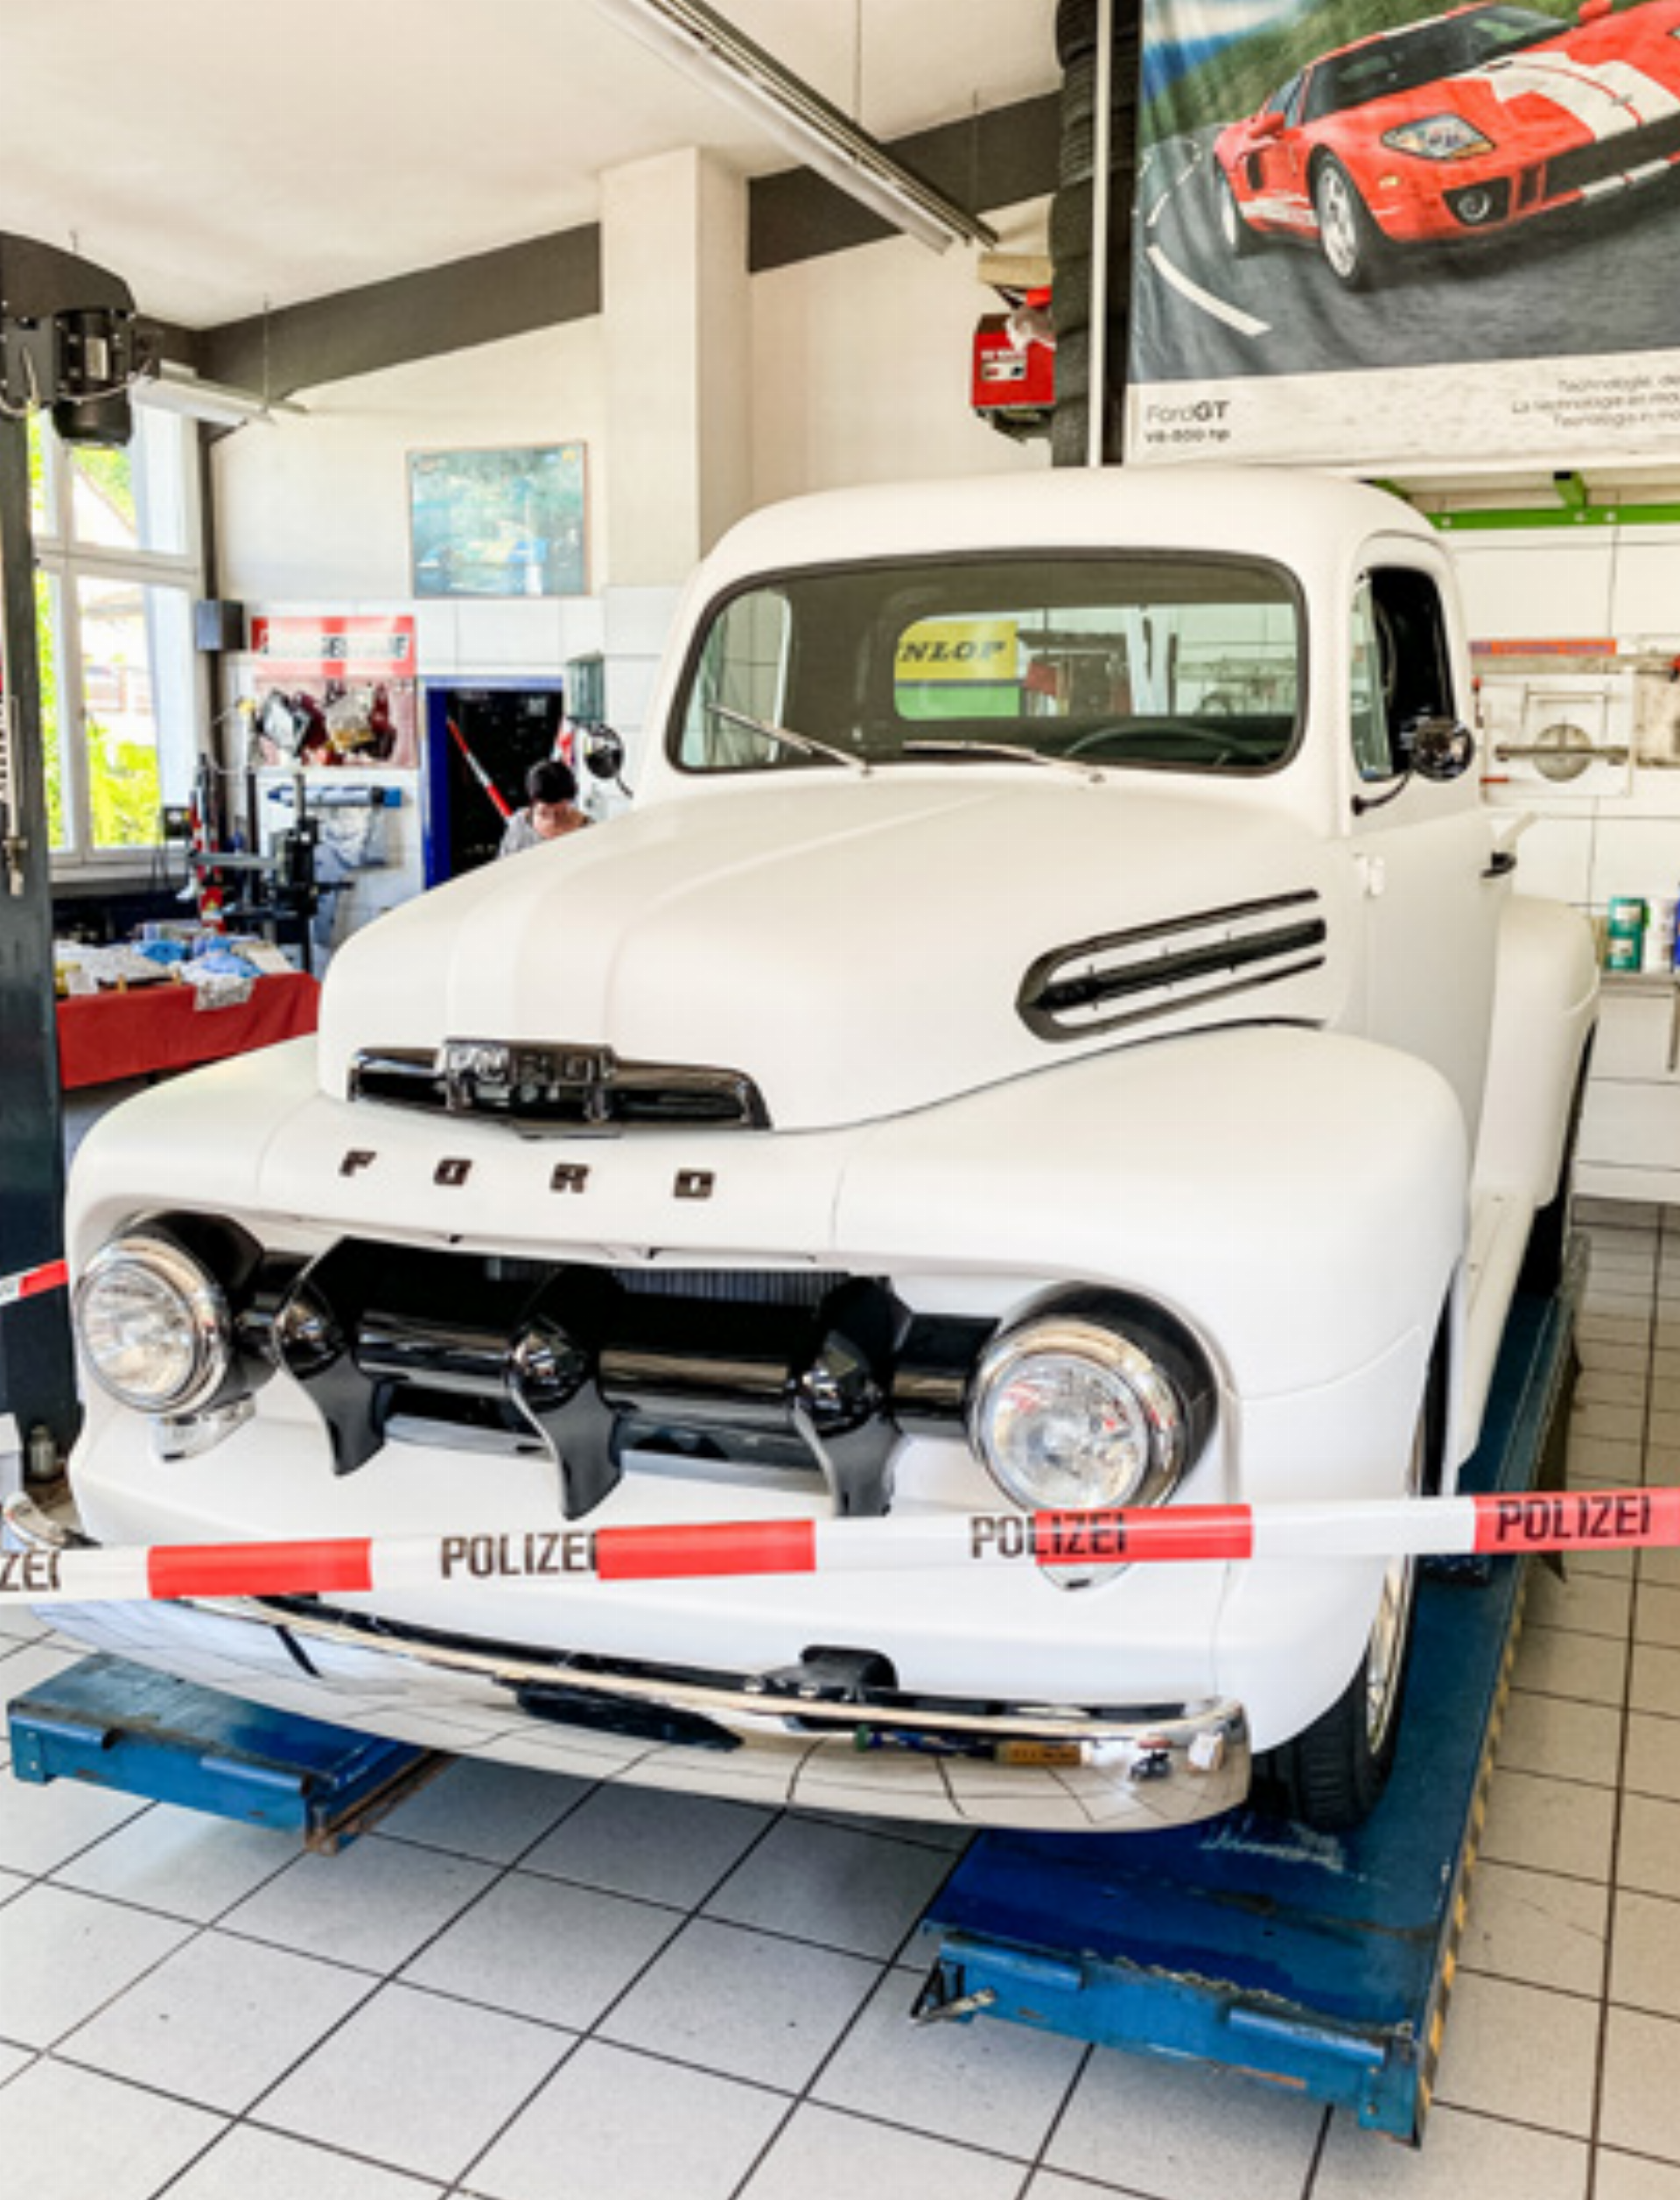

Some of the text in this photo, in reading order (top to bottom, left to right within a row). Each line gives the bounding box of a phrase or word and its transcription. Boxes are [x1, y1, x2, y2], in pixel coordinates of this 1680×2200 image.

[339, 1149, 715, 1200] FORD
[971, 1512, 1127, 1559] POLIZEI
[1496, 1496, 1650, 1542] POLIZEI
